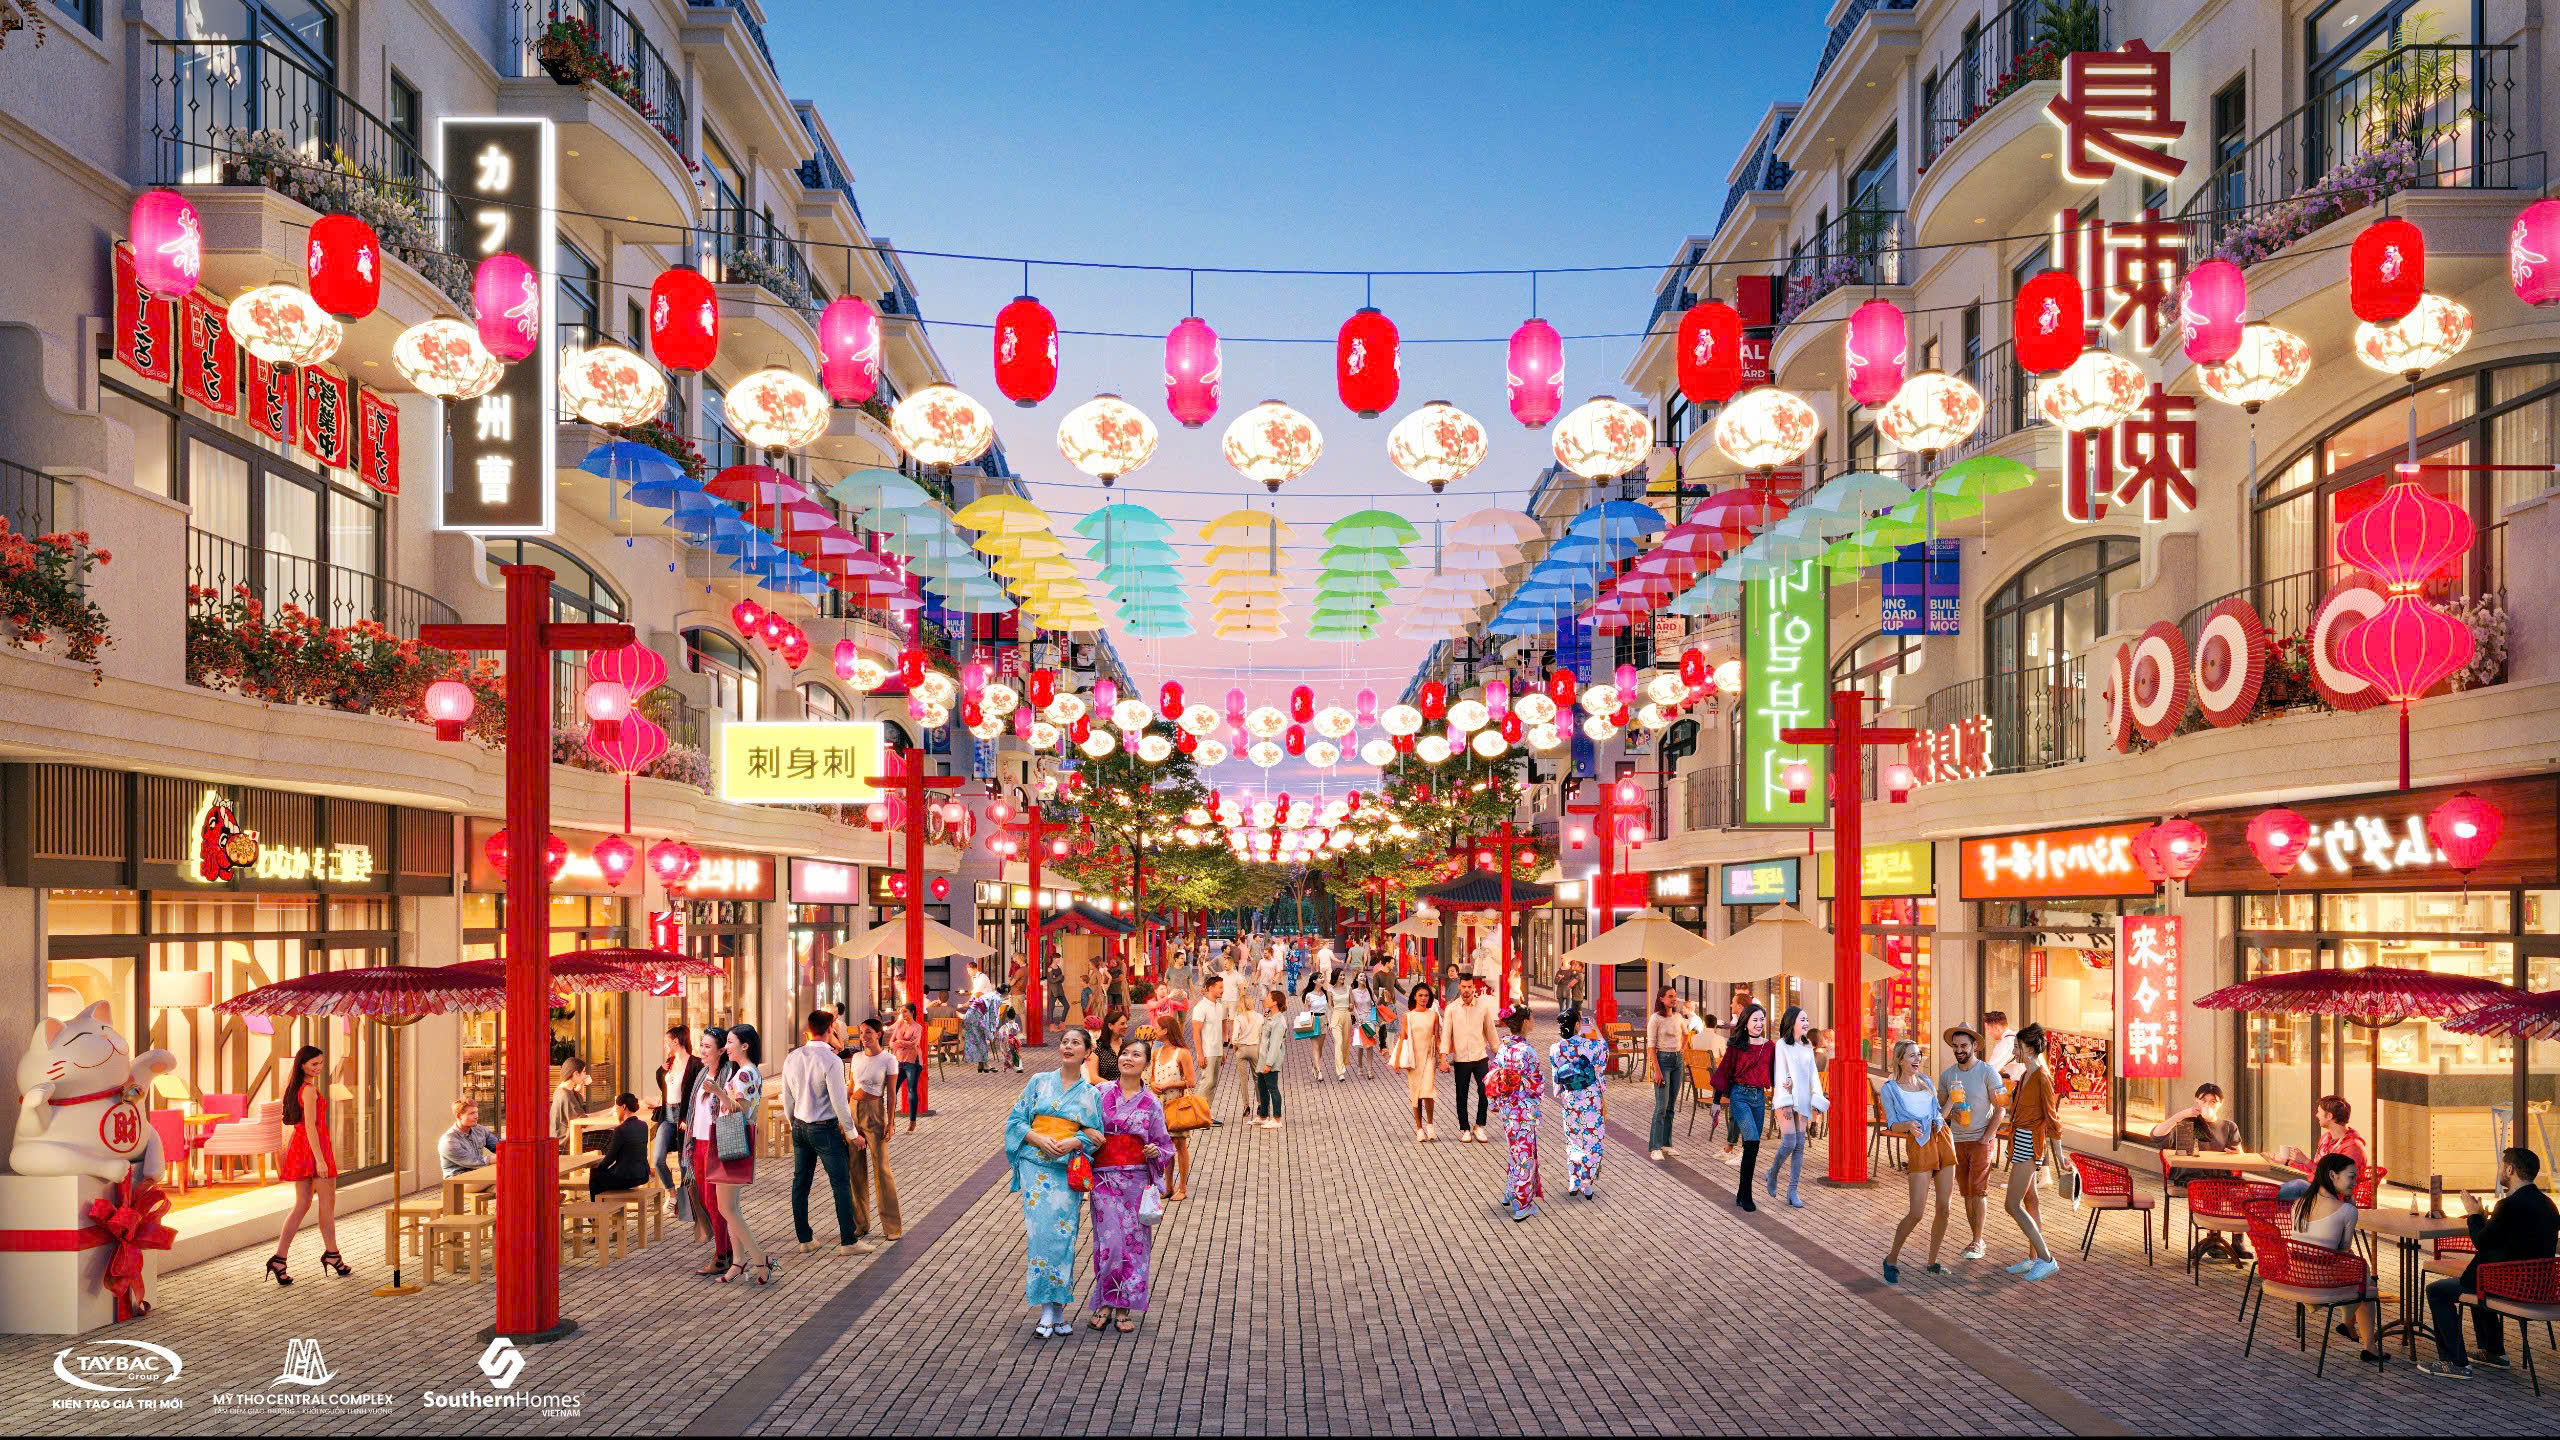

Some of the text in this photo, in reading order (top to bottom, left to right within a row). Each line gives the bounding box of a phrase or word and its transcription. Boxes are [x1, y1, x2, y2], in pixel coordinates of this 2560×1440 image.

[1883, 599, 1906, 609] ING
[747, 745, 857, 781] 刺身刺
